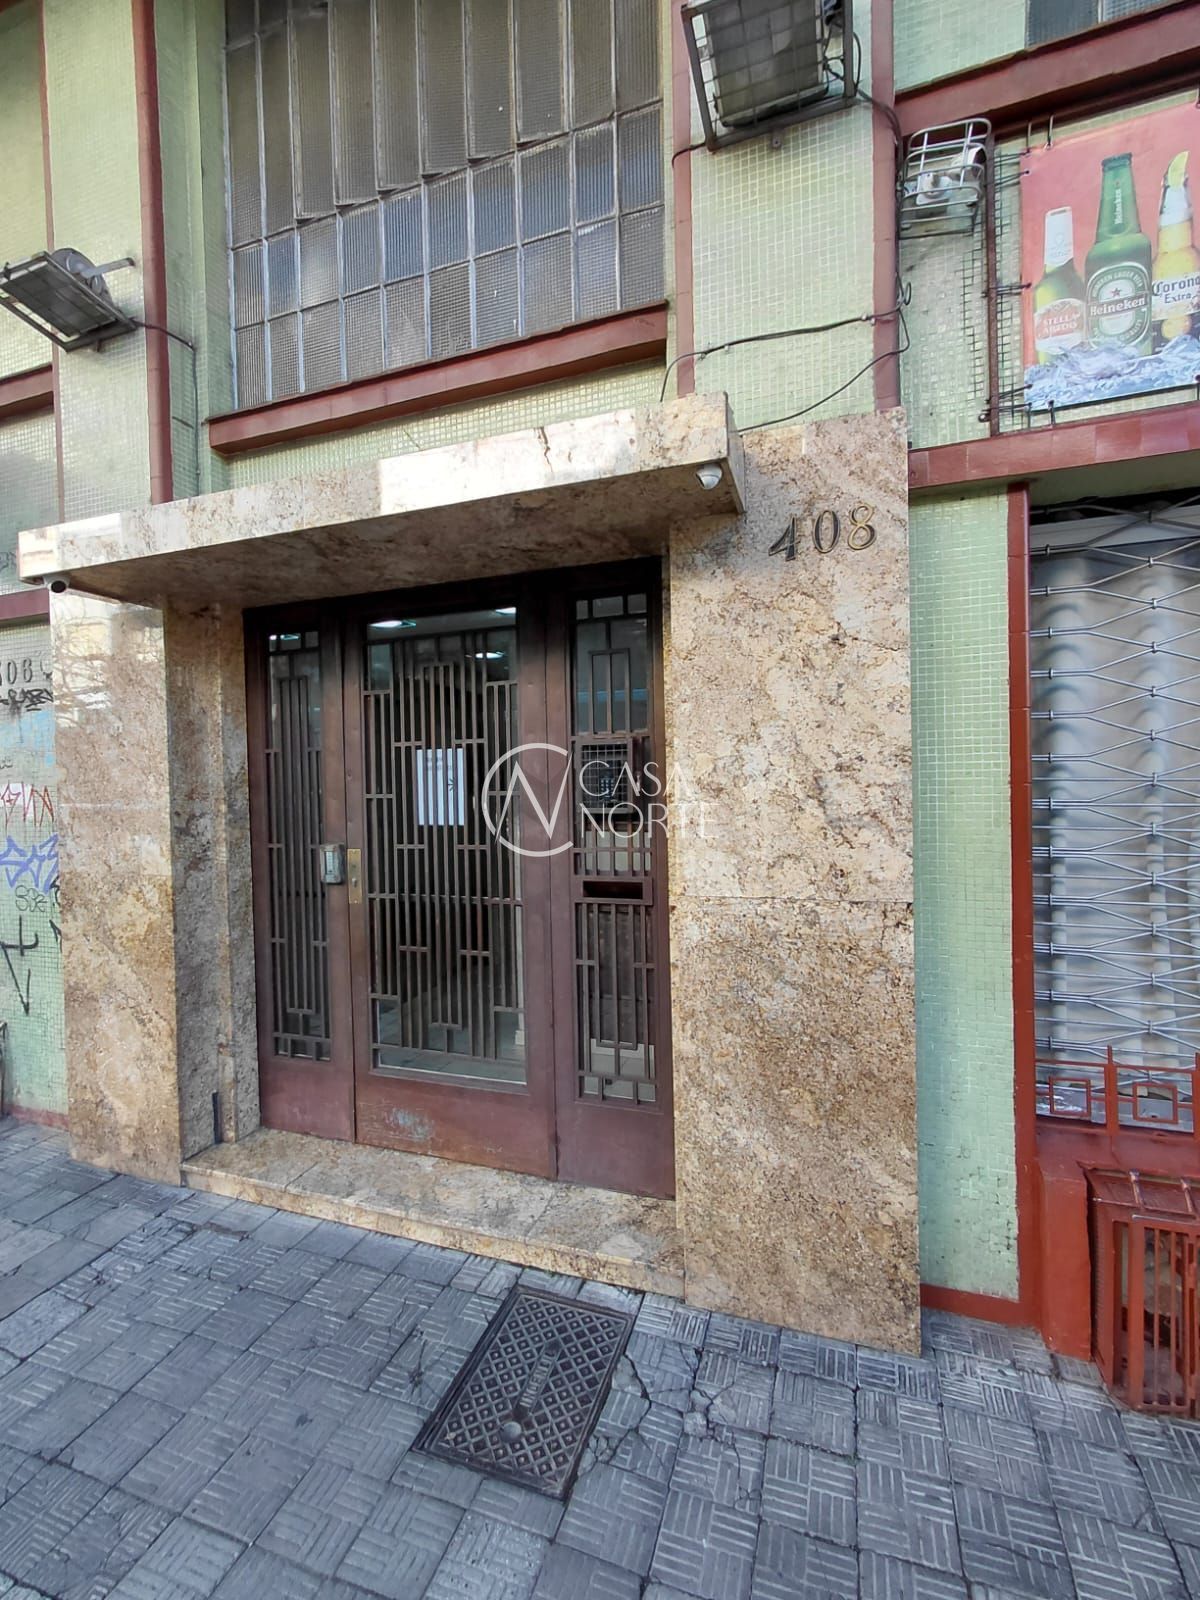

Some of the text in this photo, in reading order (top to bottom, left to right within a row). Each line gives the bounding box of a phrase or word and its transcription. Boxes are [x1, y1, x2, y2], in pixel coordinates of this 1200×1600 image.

[1090, 297, 1146, 316] Heineken
[768, 502, 878, 562] 408
[0, 657, 33, 686] 08
